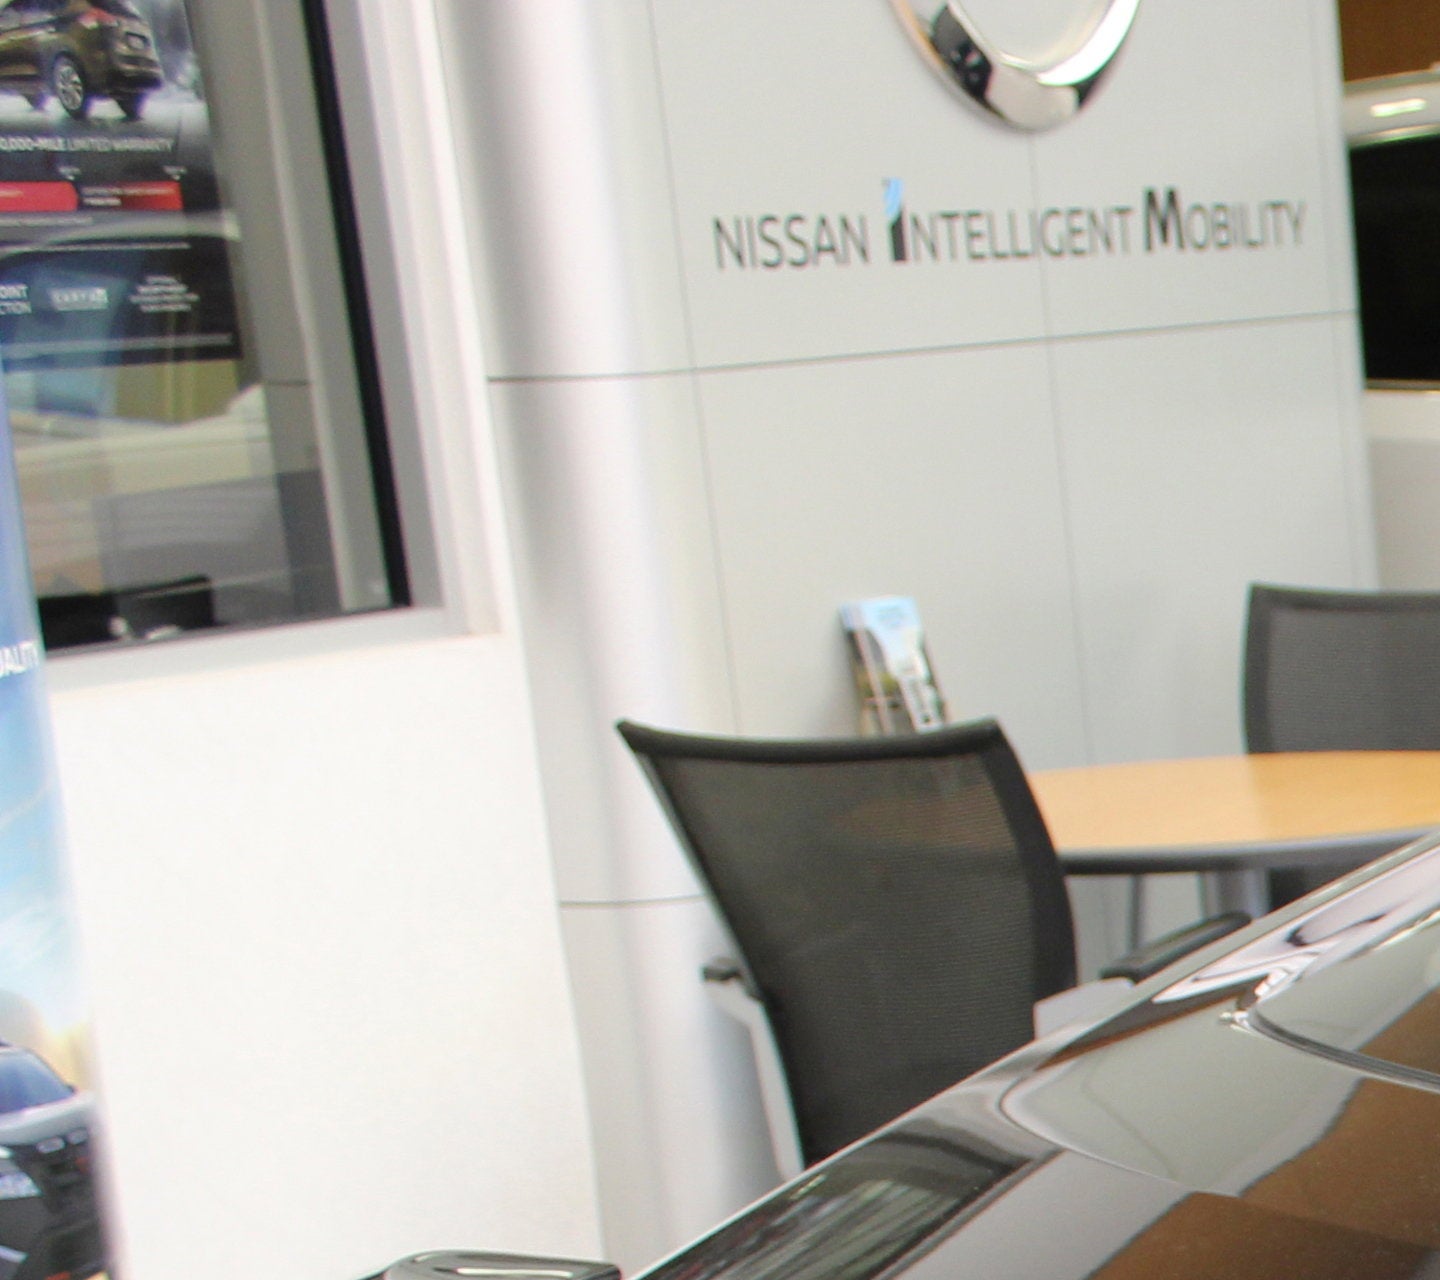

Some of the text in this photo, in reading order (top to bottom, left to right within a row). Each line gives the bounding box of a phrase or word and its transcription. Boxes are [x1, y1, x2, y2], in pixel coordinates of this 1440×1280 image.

[713, 177, 1309, 271] NISSAN INTELLIGENT MOBILITY
